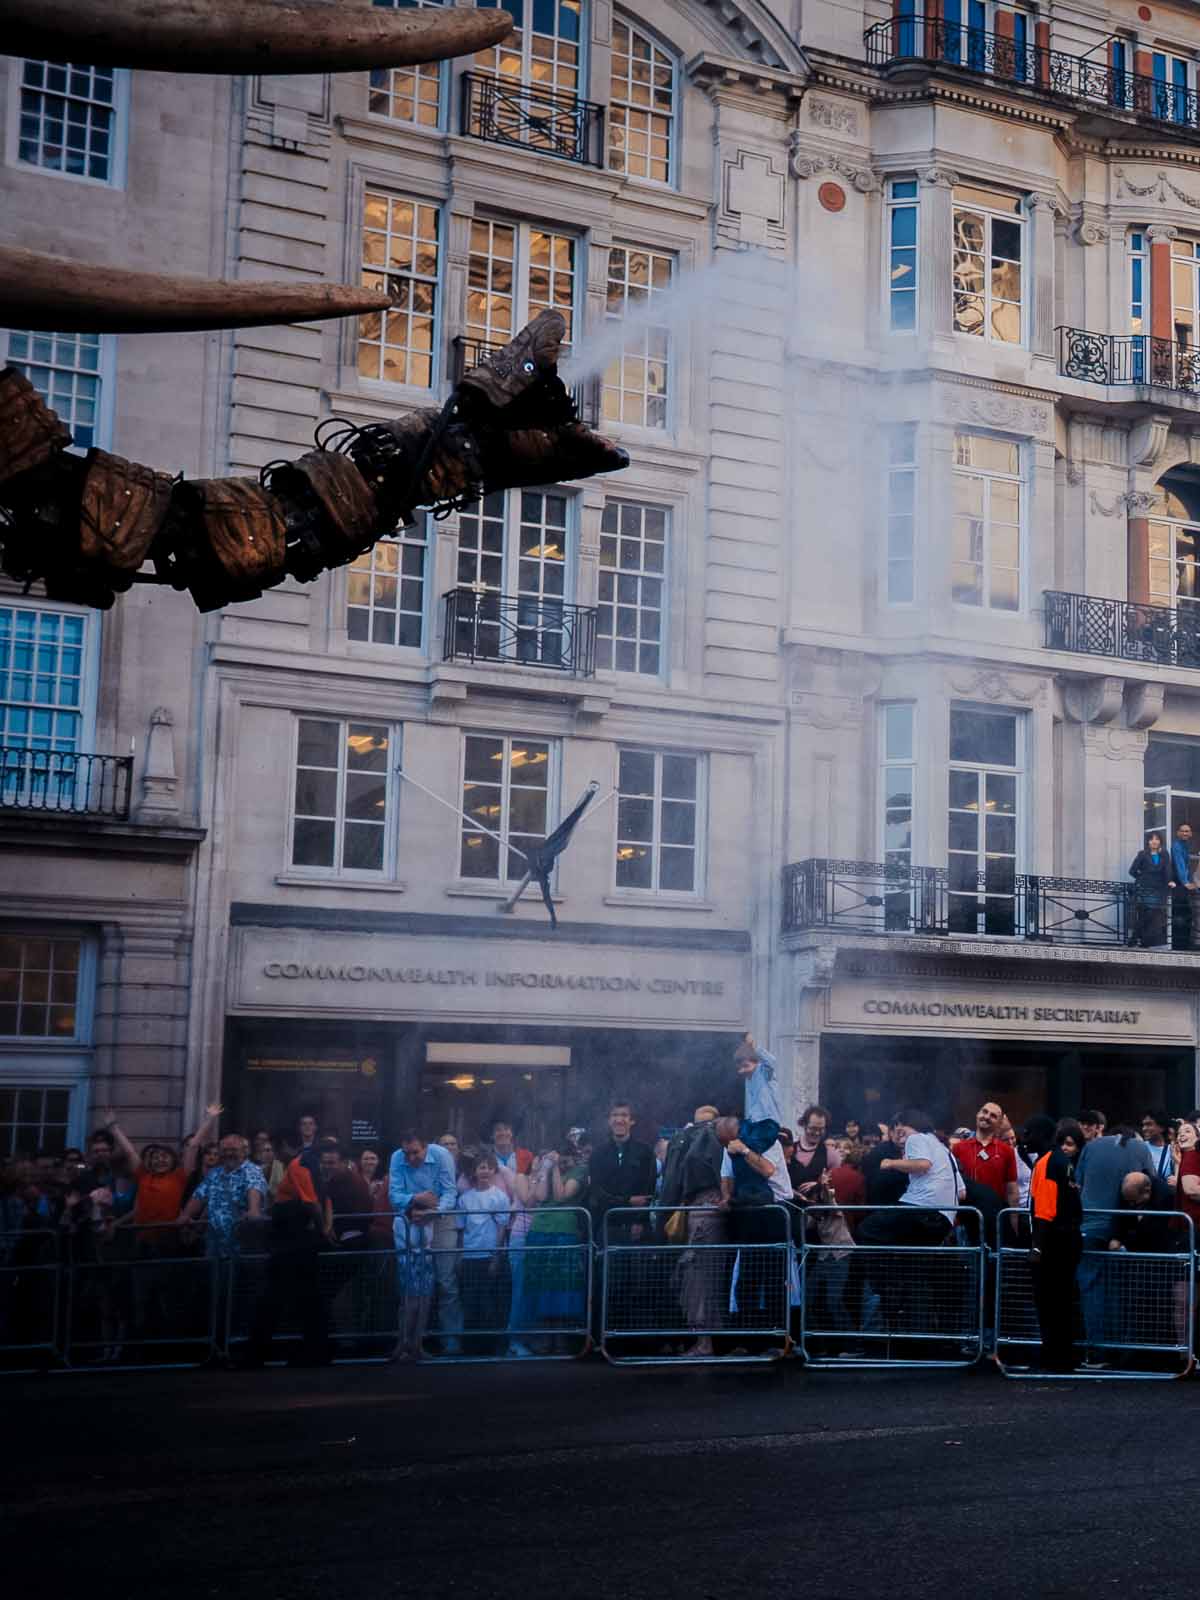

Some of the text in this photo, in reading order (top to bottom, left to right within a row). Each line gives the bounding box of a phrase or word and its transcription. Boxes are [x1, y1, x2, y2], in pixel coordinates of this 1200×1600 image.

[262, 963, 725, 997] COMMONWEALTH INFORMATION CENTRE
[863, 999, 1141, 1025] COMMONWEALTH SECRETARIAT
